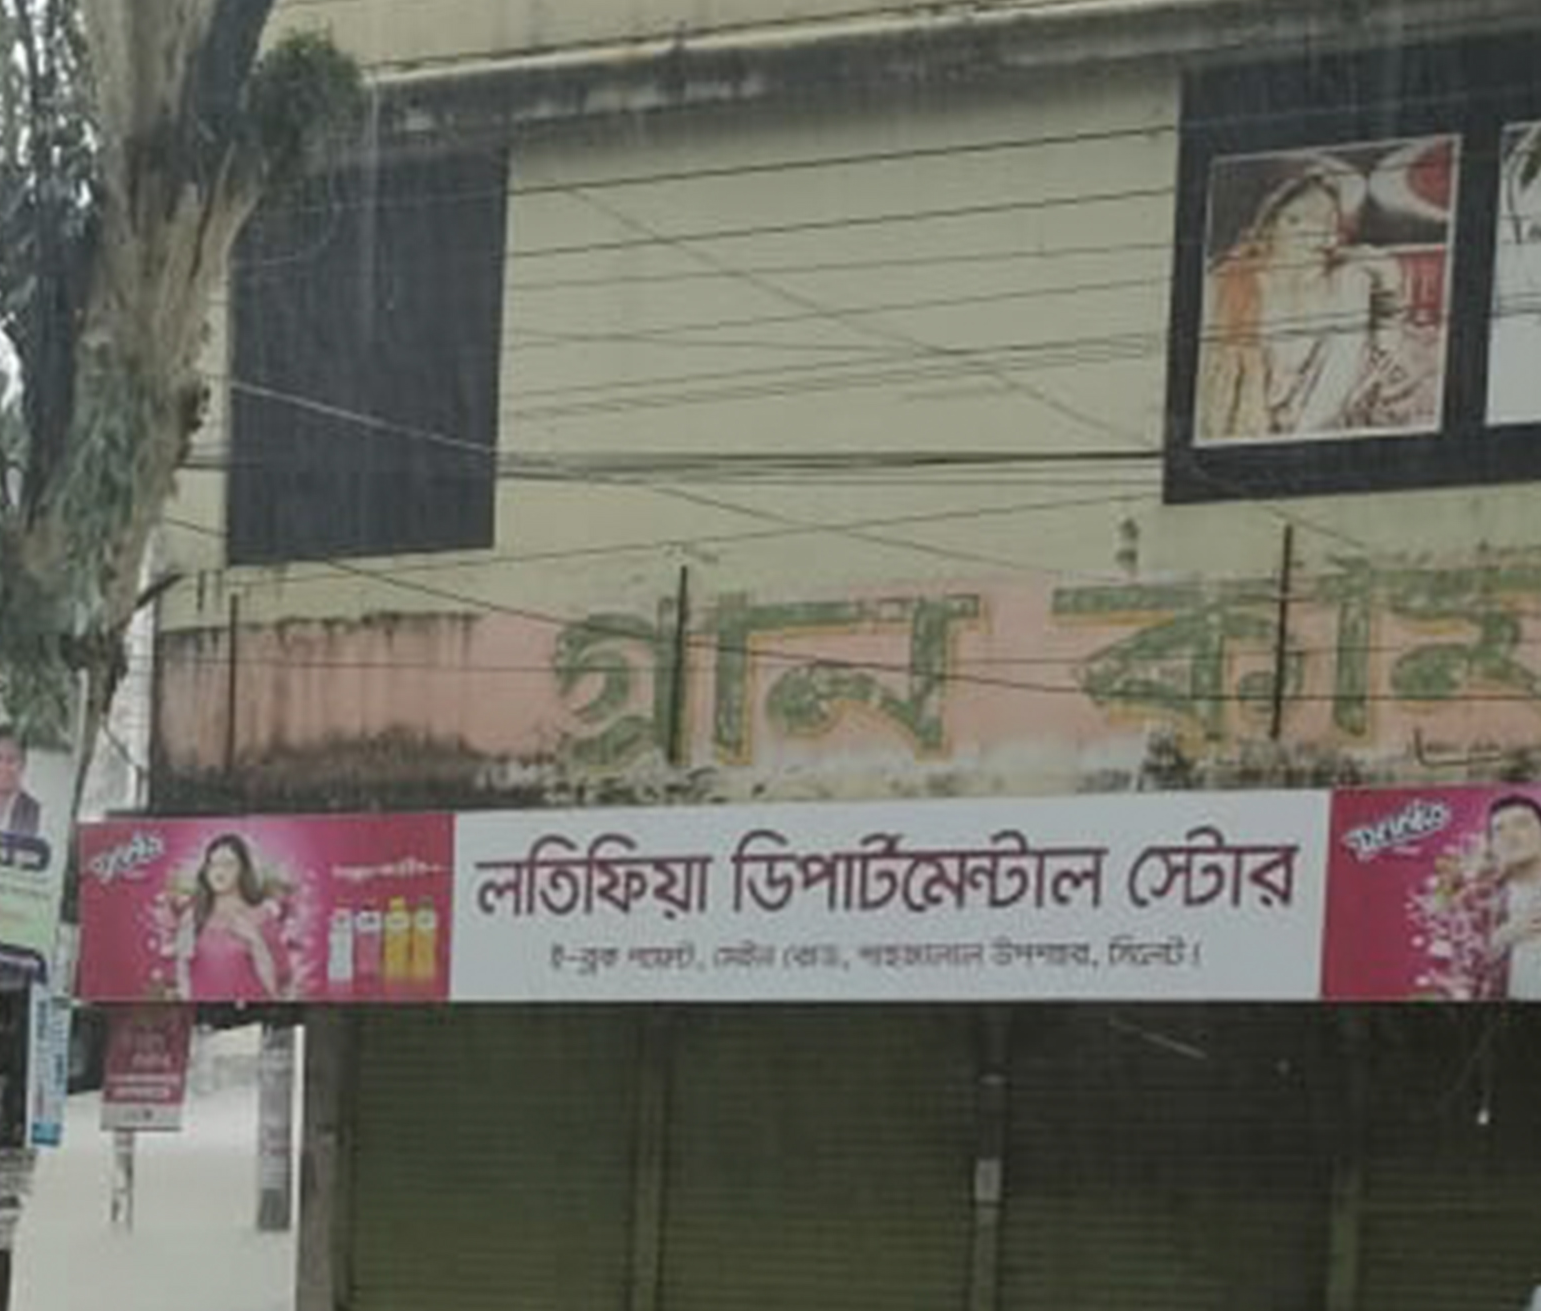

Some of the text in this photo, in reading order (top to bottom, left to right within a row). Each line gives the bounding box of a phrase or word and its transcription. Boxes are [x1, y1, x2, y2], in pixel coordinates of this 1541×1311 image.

[475, 825, 1301, 921] লতিফিয়া ডিপার্টমেন্টাল স্টোর
